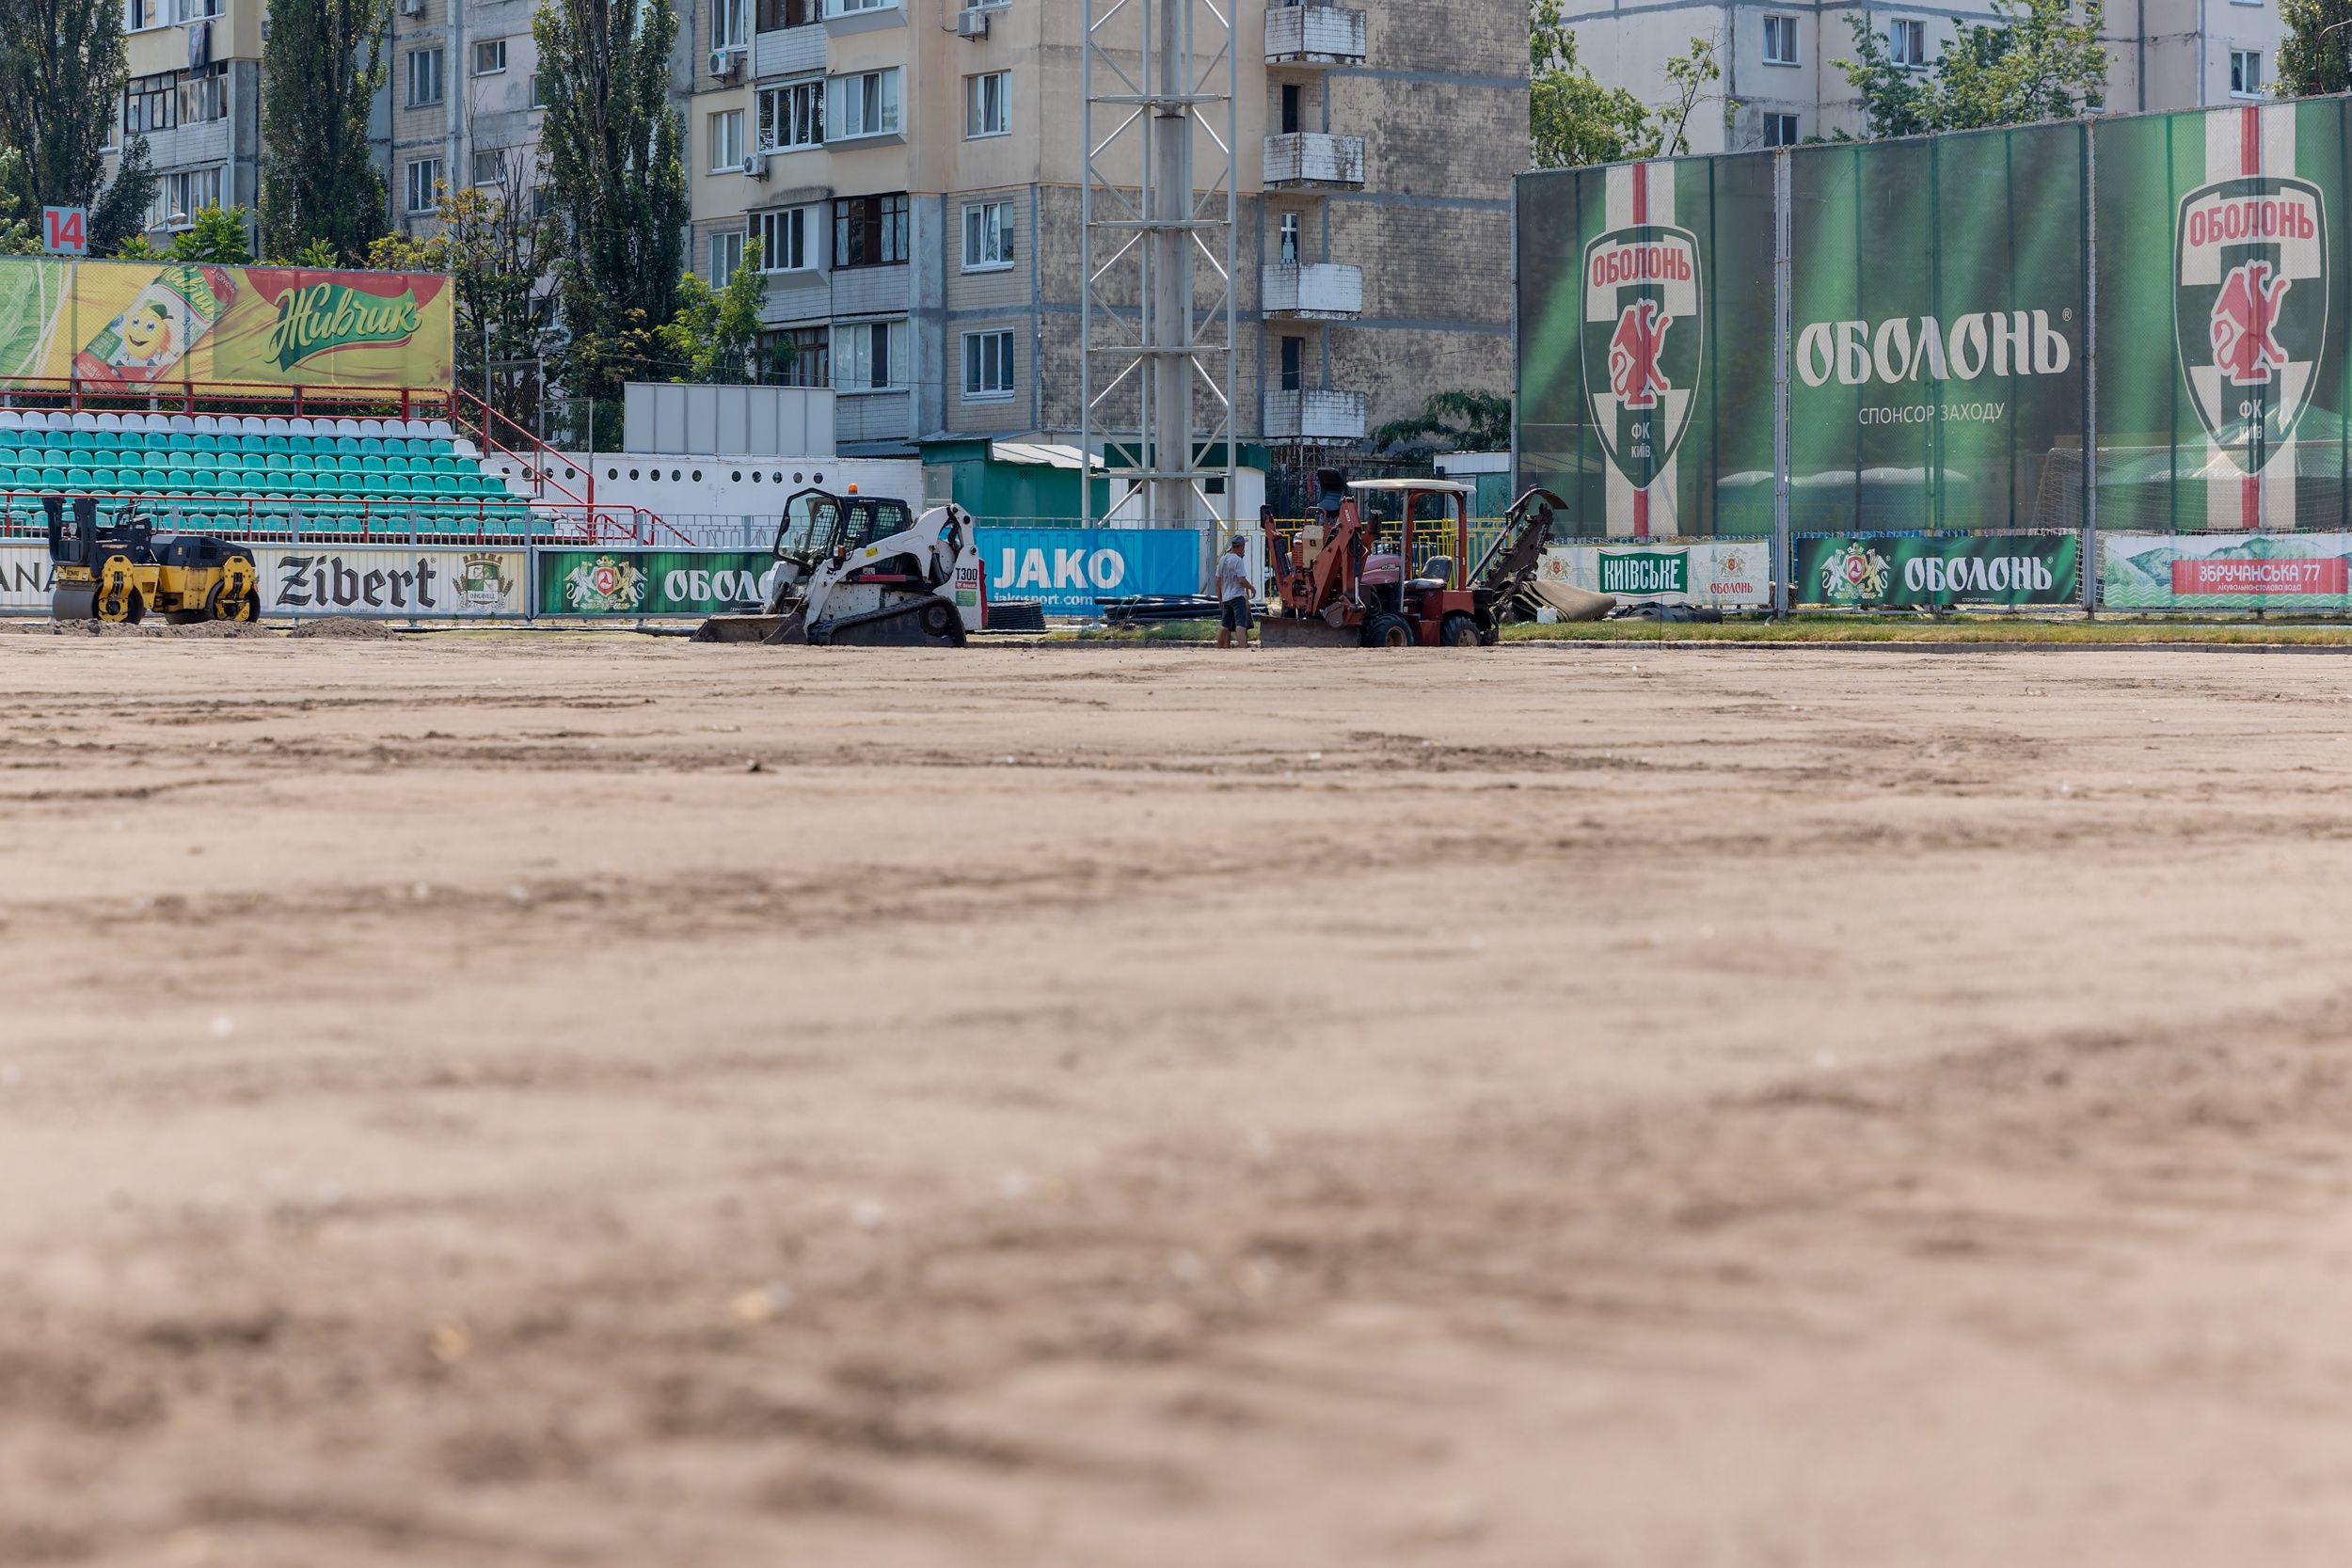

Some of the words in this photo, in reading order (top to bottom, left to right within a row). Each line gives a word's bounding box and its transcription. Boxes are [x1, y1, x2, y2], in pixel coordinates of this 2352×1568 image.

[45, 211, 85, 249] 14
[2190, 201, 2314, 246] ОБОЛОНЬ
[1593, 247, 1691, 287] ОБОЛОНЬ
[263, 282, 421, 363] Живчик
[1796, 309, 2070, 387] ОБОЛОНЬ
[1859, 405, 1934, 424] СПОНСОР
[1940, 403, 2005, 421] ЗАХОДУ
[2239, 399, 2263, 419] ФК
[1631, 422, 1650, 439] ФК
[1631, 443, 1651, 458] КИЇВ
[276, 555, 437, 608] Zibert
[955, 567, 977, 580] T300
[993, 547, 1125, 589] JAKO
[1604, 557, 1680, 590] КИЇВСЬКЕ
[1904, 556, 2053, 592] ОБОЛОНЬ
[2199, 564, 2299, 582] ЗБРУЧАНСЬКА
[2303, 564, 2321, 581] 77
[1709, 581, 1754, 594] ОБОЛОНЬ
